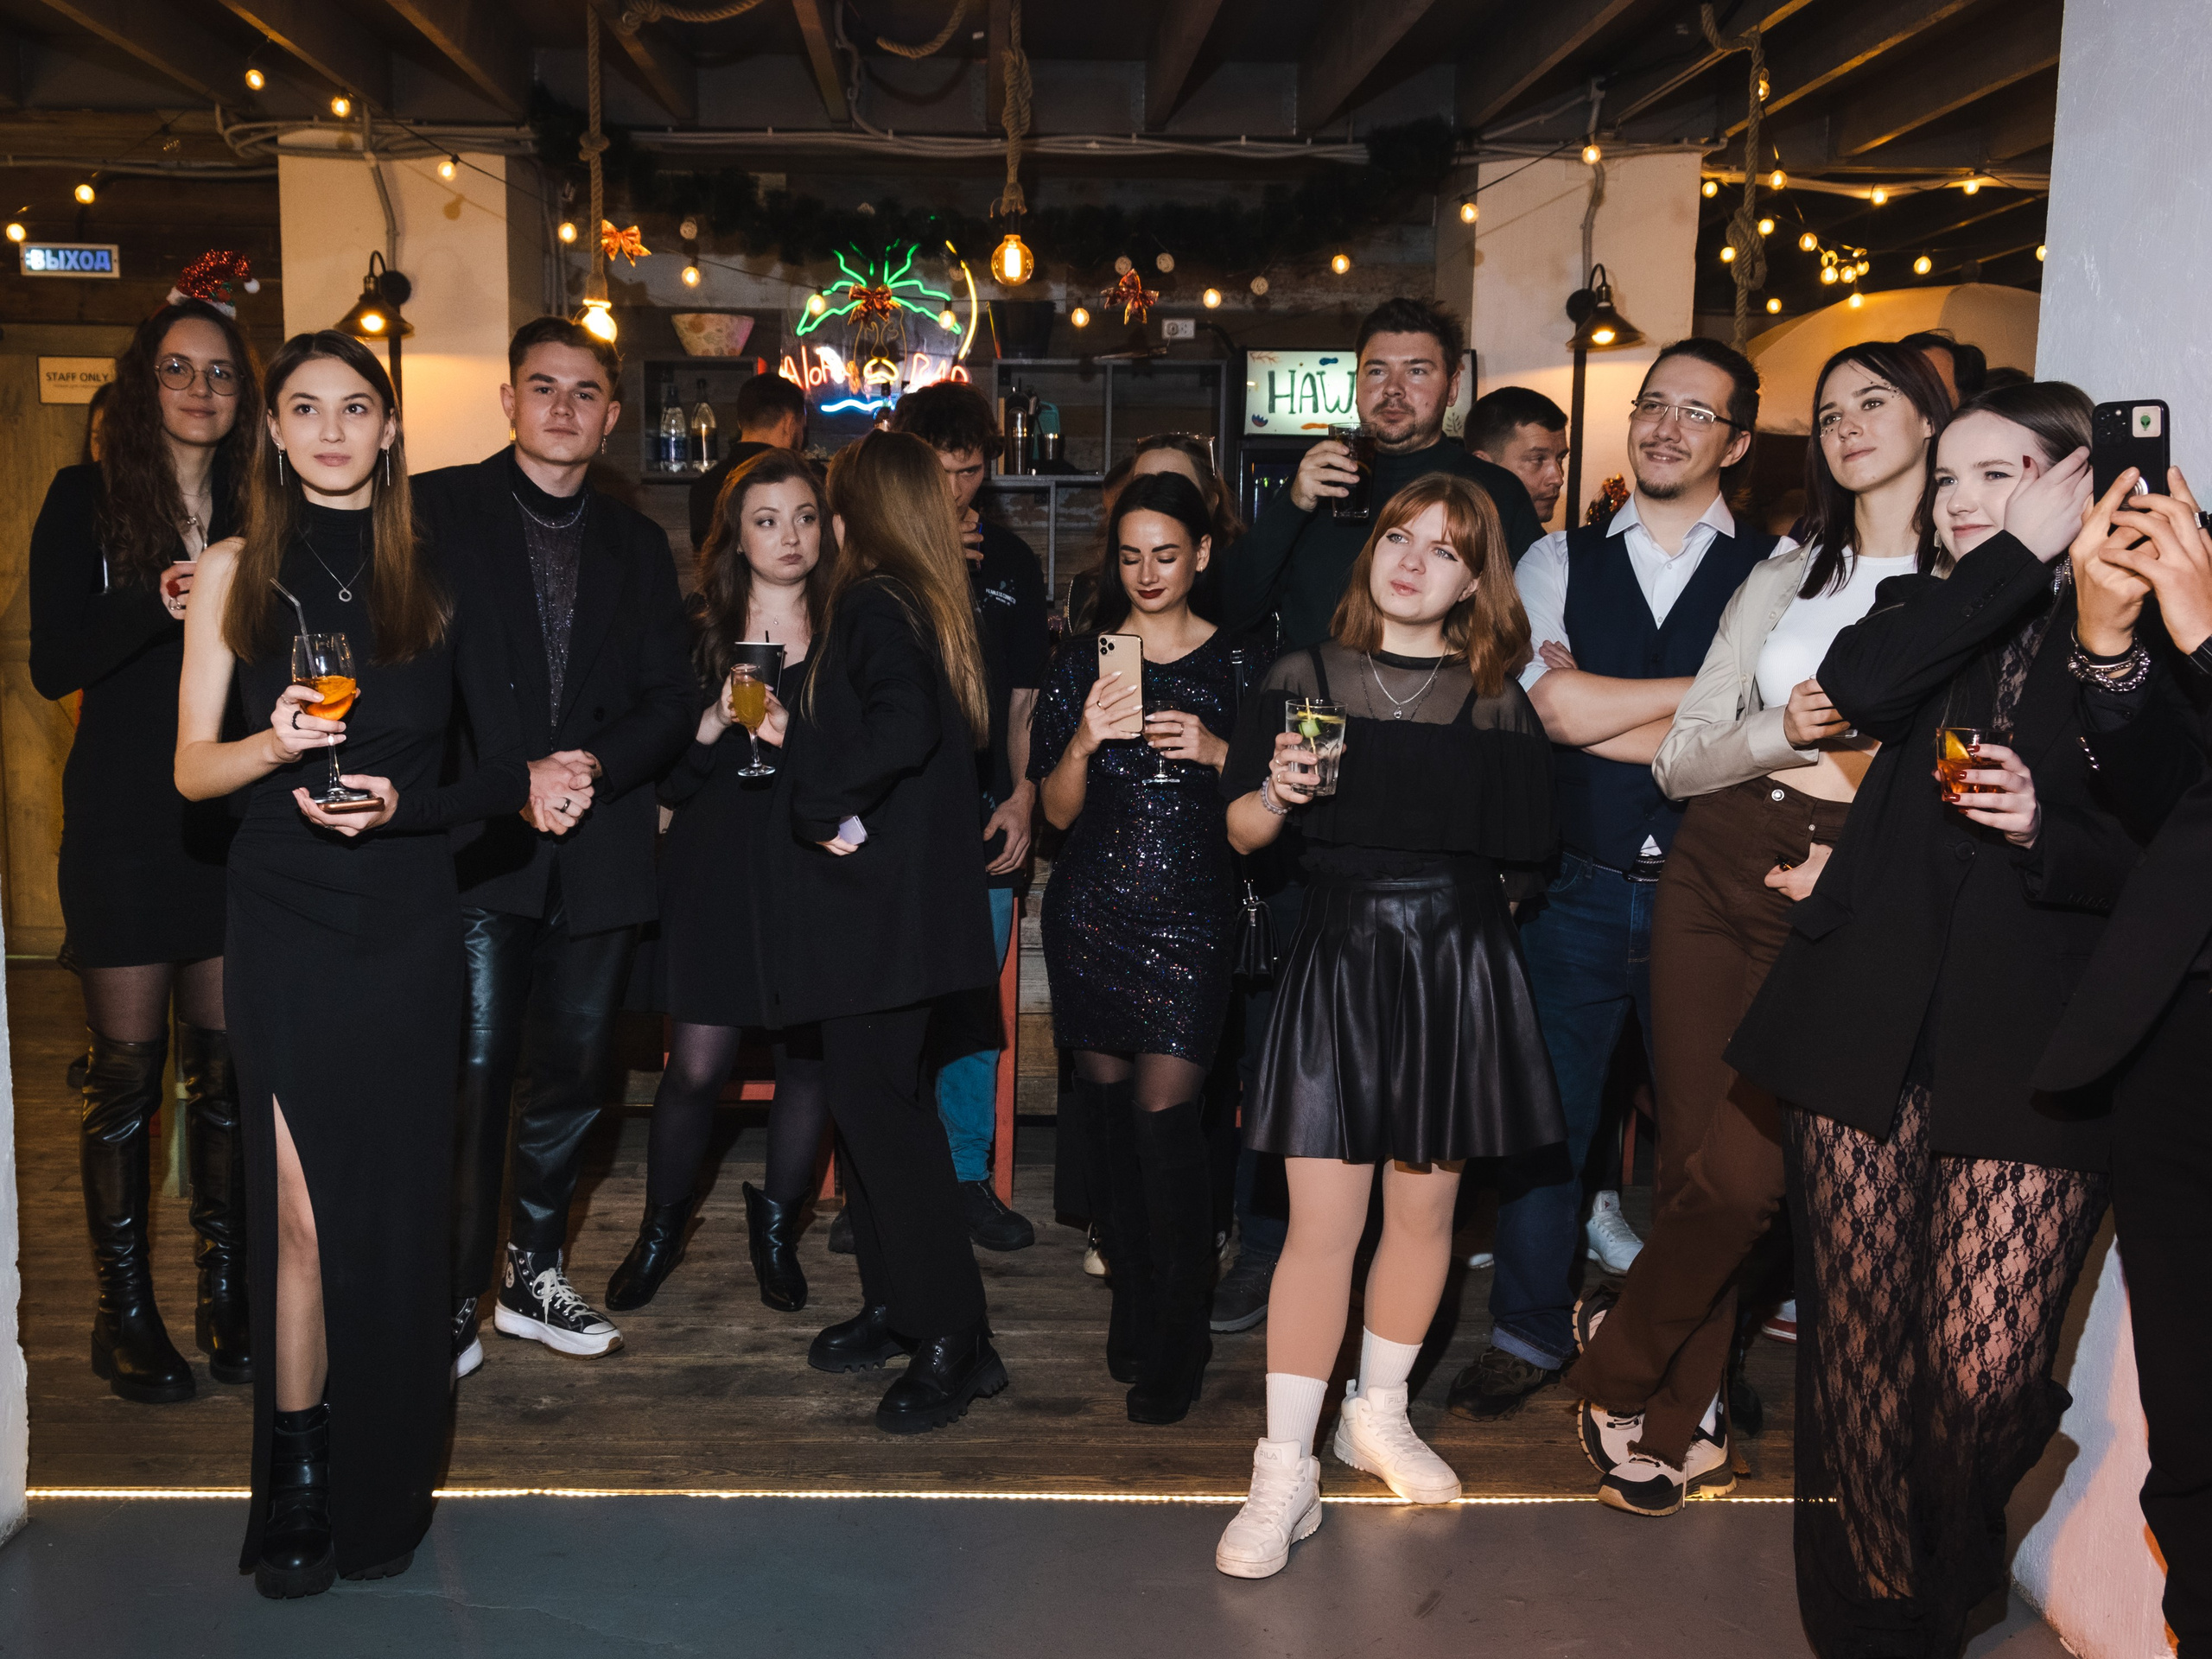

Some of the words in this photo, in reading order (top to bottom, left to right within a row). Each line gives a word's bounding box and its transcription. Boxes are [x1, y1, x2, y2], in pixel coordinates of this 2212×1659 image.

[30, 249, 111, 271] ВЫХОД
[45, 372, 77, 382] STAFF
[79, 372, 109, 382] ONLY
[1259, 1449, 1279, 1460] FILA
